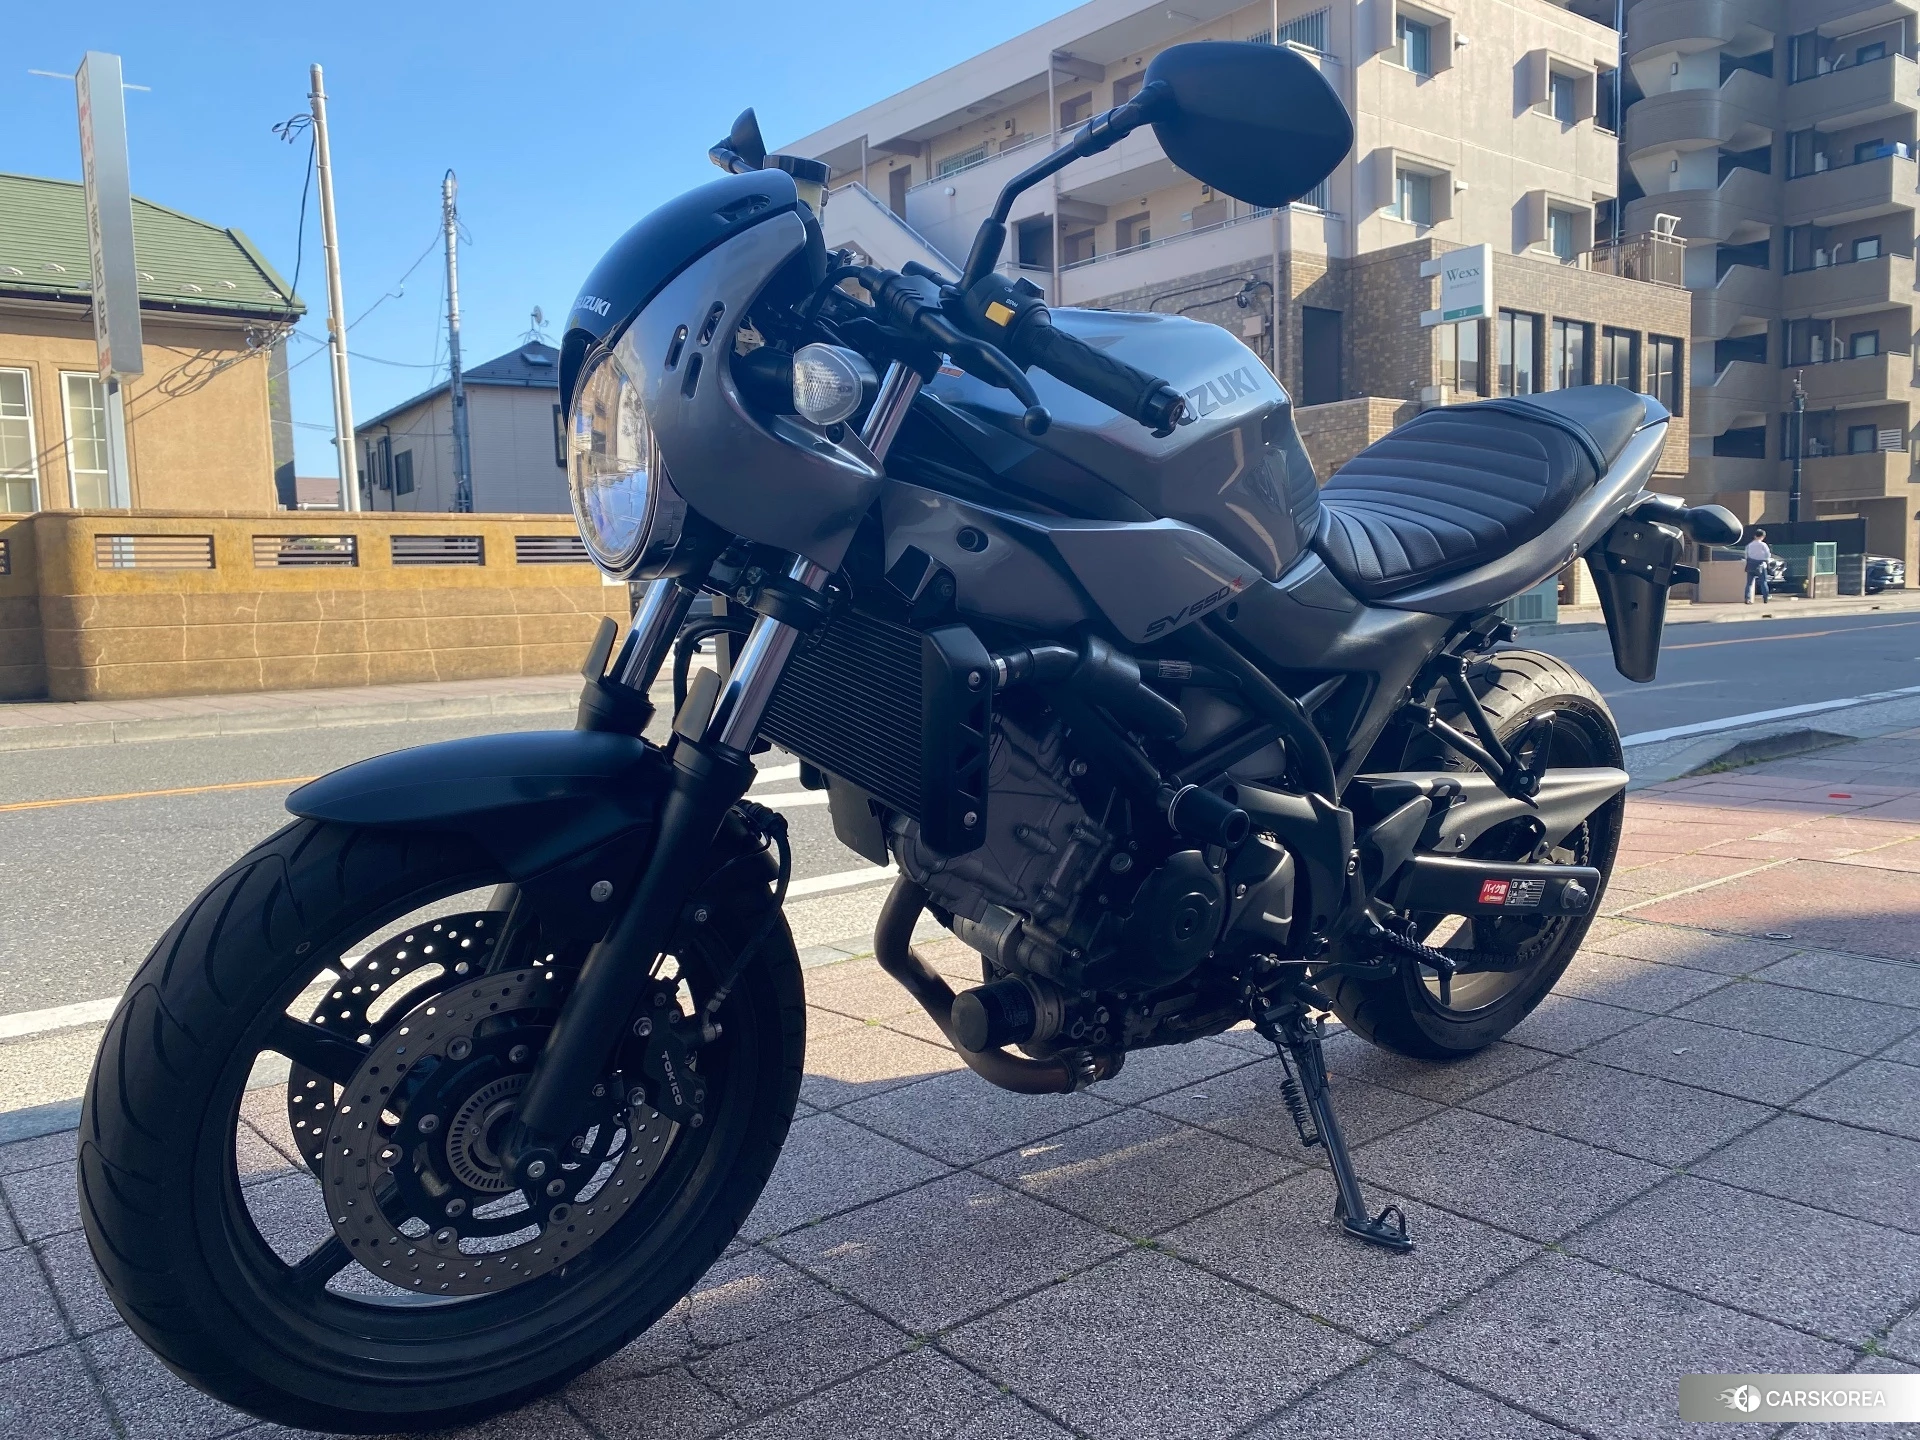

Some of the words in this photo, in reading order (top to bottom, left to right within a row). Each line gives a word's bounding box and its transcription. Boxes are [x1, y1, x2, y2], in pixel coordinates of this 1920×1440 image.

[1446, 267, 1480, 282] Wexx
[1177, 366, 1262, 426] UZUKI
[661, 1050, 683, 1106] TOKICO
